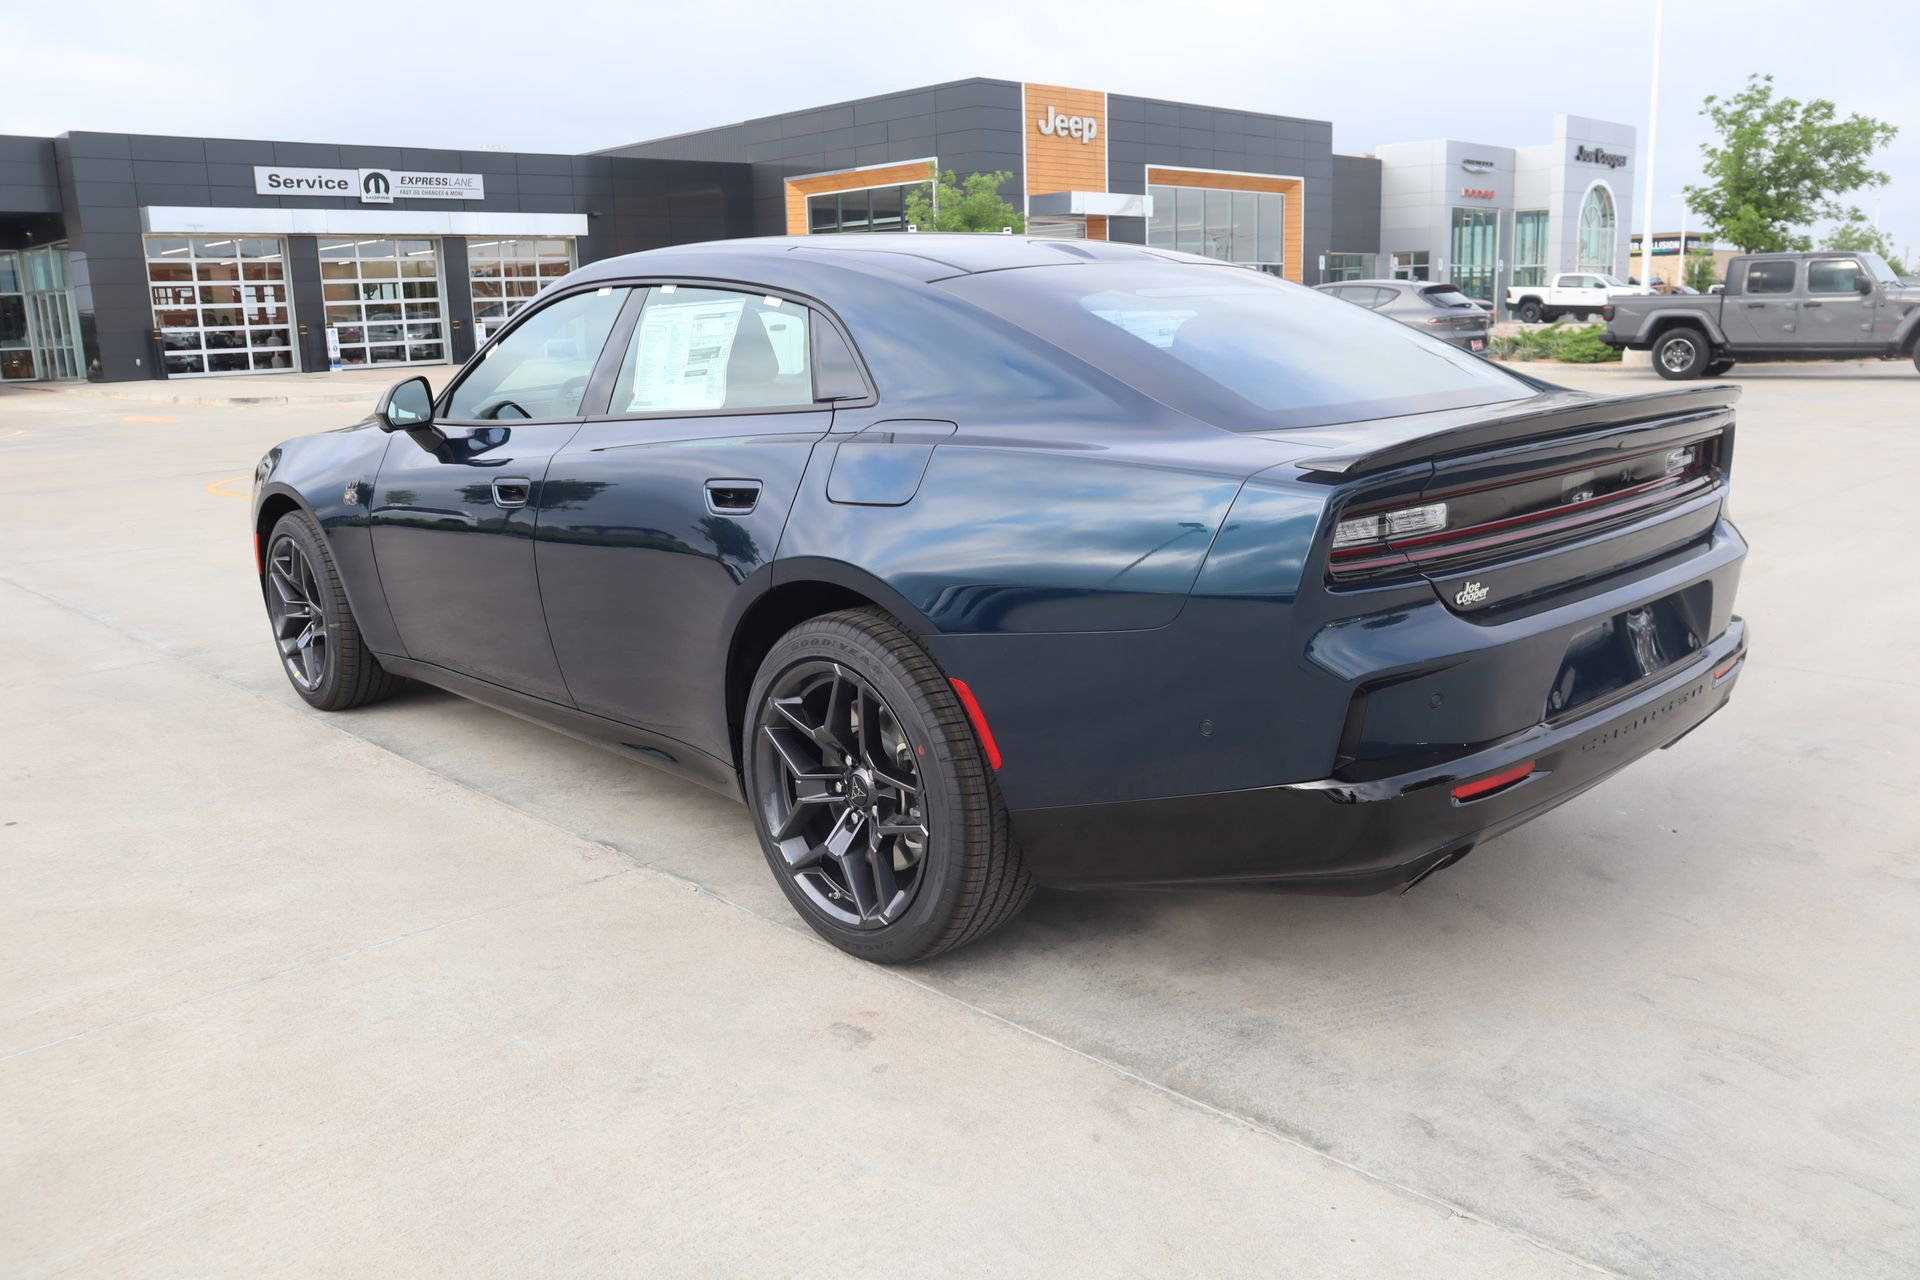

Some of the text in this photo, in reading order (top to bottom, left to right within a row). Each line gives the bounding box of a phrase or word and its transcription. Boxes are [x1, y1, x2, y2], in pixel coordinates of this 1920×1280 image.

[1038, 105, 1097, 145] Jeep
[267, 173, 349, 190] Service
[1455, 586, 1490, 604] Cooper
[1464, 581, 1480, 594] Joe
